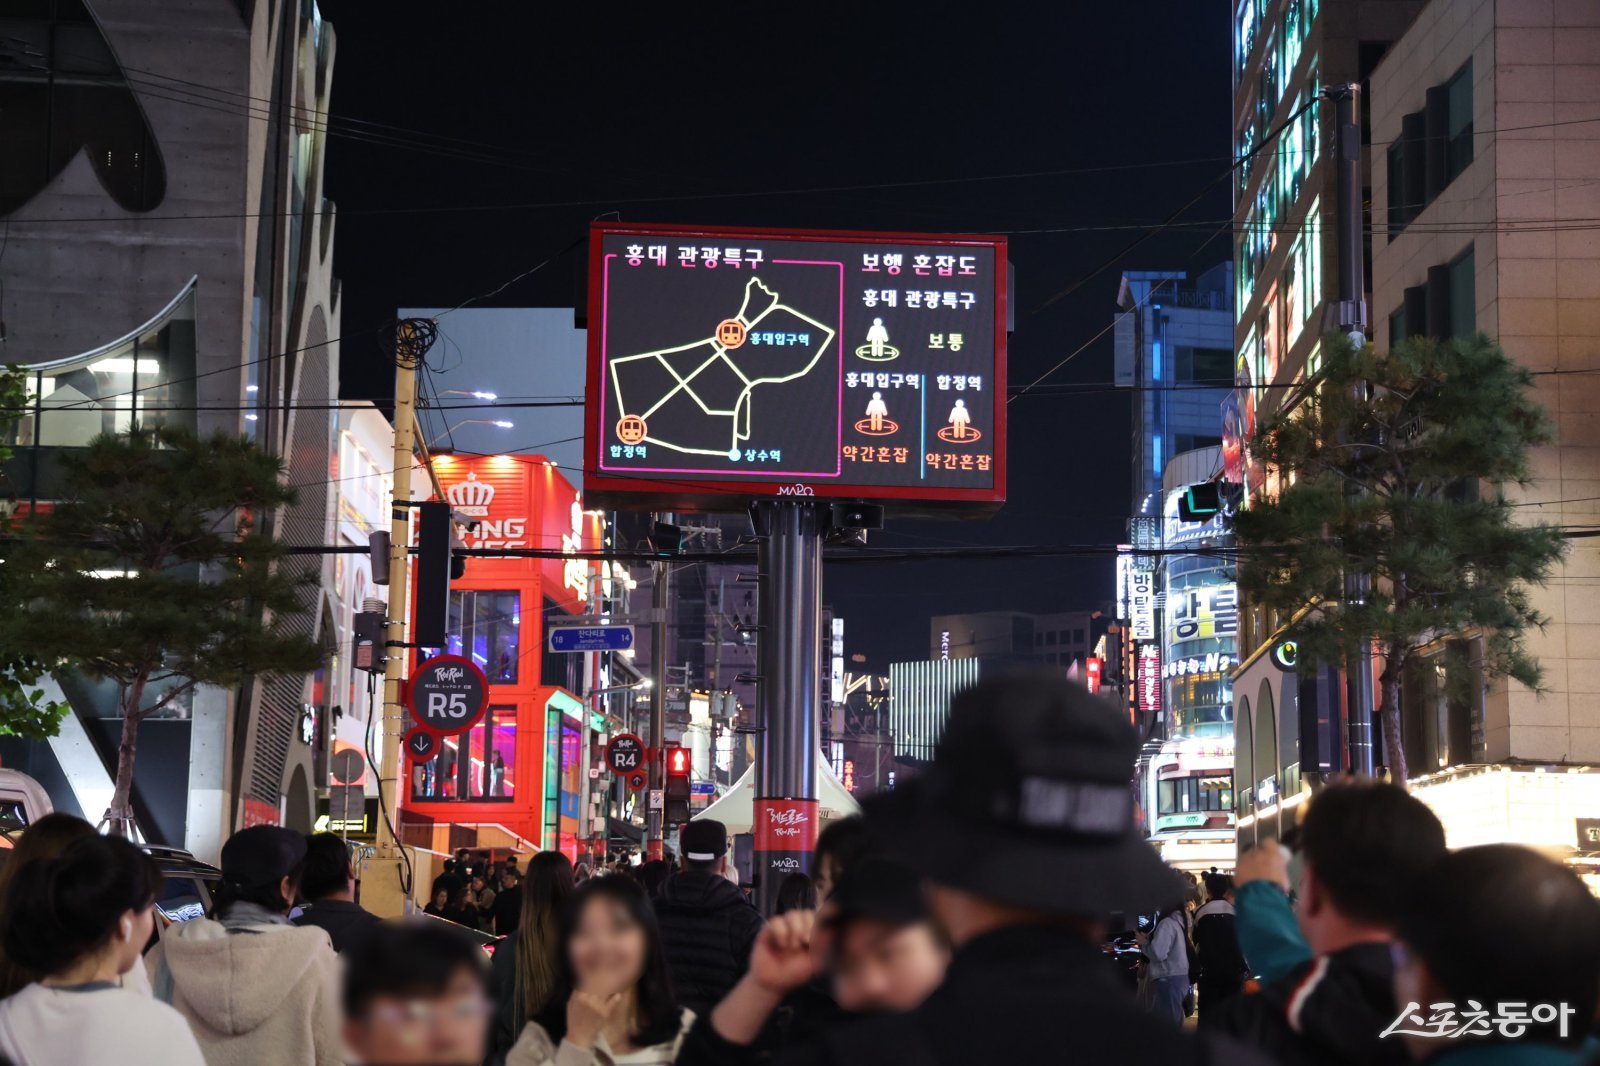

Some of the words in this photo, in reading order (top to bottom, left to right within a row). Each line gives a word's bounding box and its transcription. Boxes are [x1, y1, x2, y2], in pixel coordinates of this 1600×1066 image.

[624, 244, 667, 267] 홍대
[677, 246, 765, 269] 관광특구
[861, 253, 903, 275] 보행
[912, 255, 977, 277] 혼잡도
[862, 289, 897, 308] 홍대
[905, 291, 976, 310] 관광특구
[750, 333, 809, 346] 홍대입구역
[928, 333, 964, 352] 보통
[845, 372, 919, 389] 홍대입구역
[937, 374, 982, 391] 합정역
[610, 445, 647, 459] 합정역
[744, 450, 781, 462] 상수역
[842, 445, 909, 463] 약간혼잡
[925, 453, 992, 471] 약간혼잡
[776, 483, 815, 497] MAPO
[1133, 574, 1151, 636] 방탈출
[554, 636, 564, 644] 18
[1204, 652, 1230, 672] N2
[427, 693, 467, 718] R5
[615, 753, 636, 767] R4
[771, 857, 800, 868] MAPO
